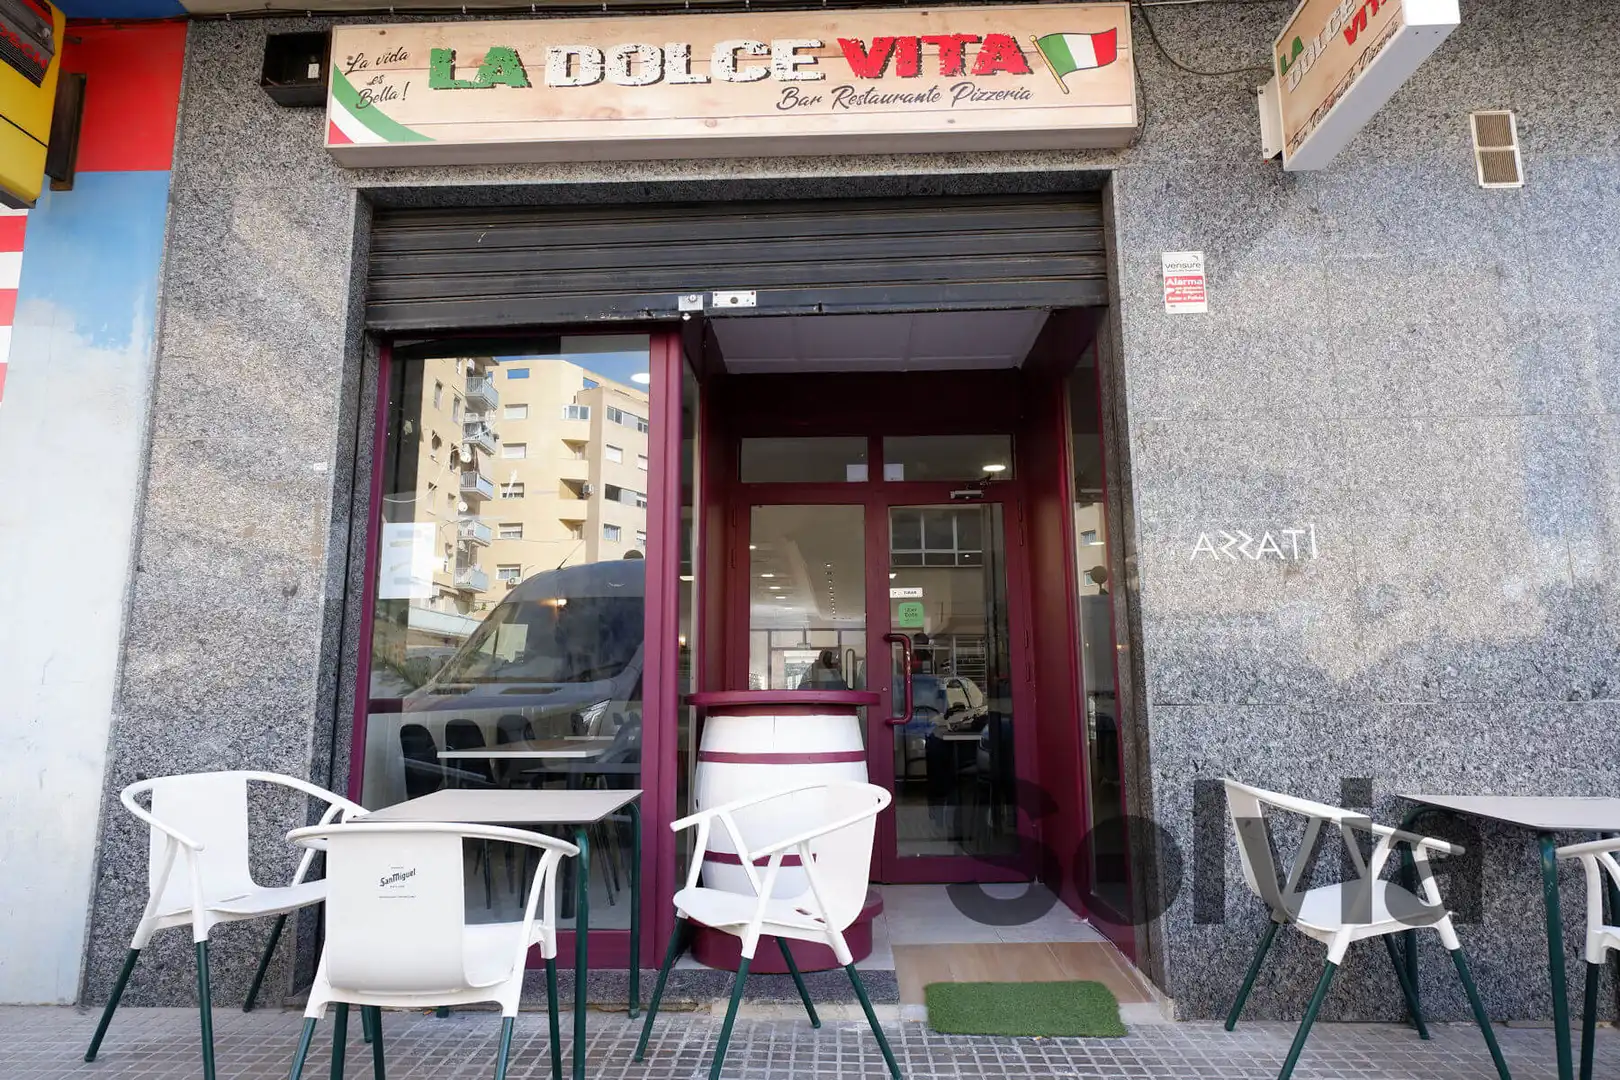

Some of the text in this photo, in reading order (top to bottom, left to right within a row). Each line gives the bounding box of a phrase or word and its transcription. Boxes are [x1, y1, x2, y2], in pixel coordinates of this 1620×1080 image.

[344, 46, 408, 76] La vida
[429, 33, 1034, 90] LA DOLCE VITA
[1280, 35, 1304, 77] LA
[366, 74, 385, 86] es
[776, 81, 1034, 110] Bar Restaurante Pizzeria
[1167, 277, 1202, 285] Alarma
